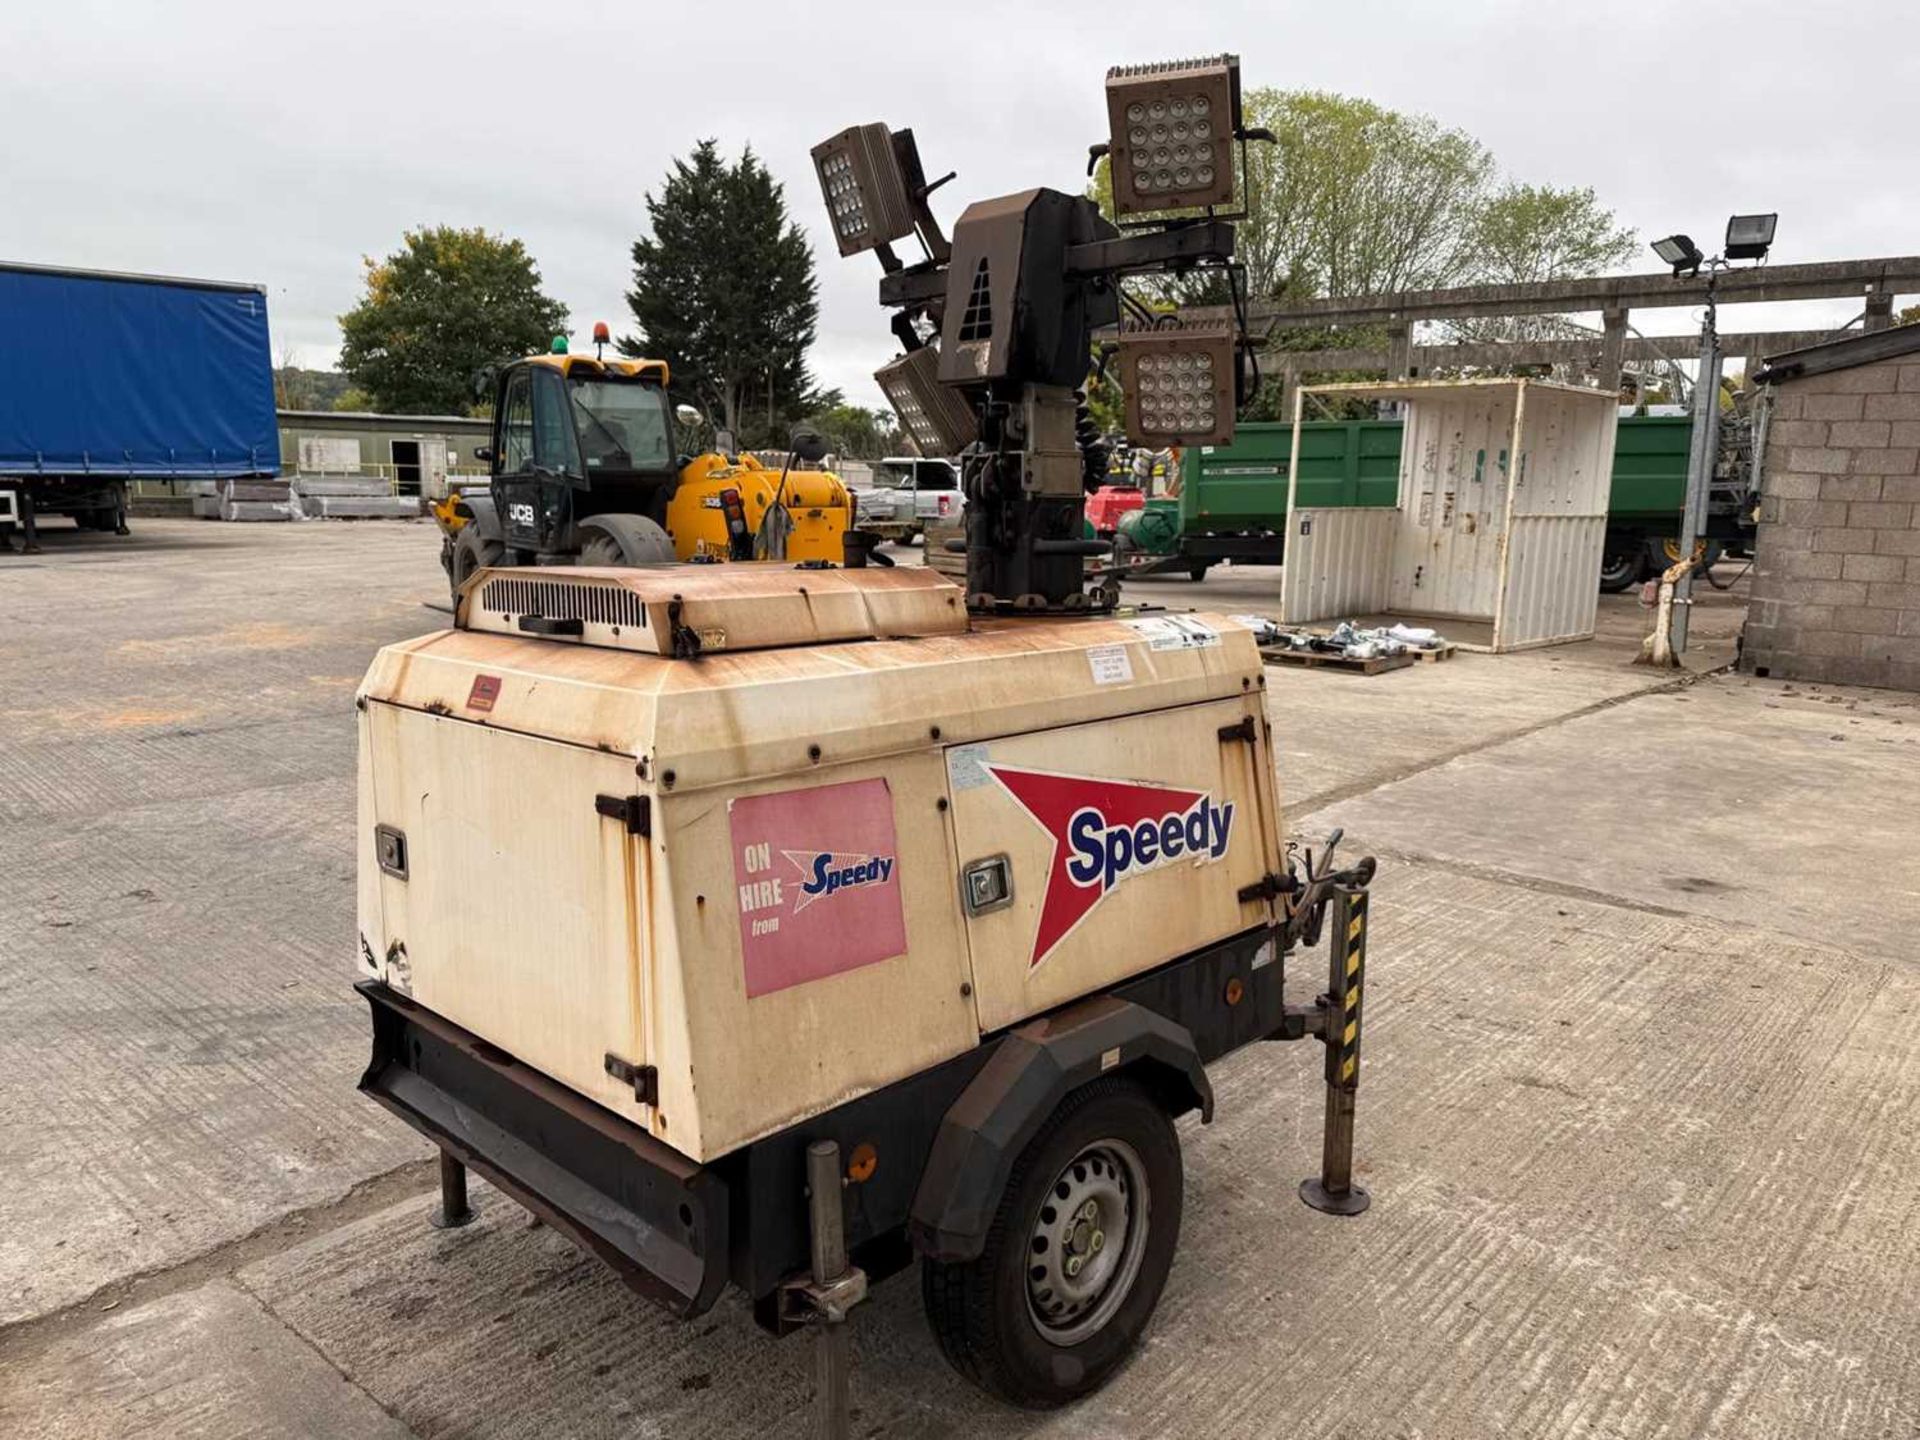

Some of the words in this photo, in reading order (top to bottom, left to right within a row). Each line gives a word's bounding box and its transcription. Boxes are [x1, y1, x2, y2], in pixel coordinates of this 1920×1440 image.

[509, 503, 534, 521] JCB
[744, 842, 772, 873] ON
[1068, 796, 1234, 892] Speedy
[802, 852, 895, 895] Speedy
[739, 878, 783, 913] HIRE
[751, 917, 779, 937] from
